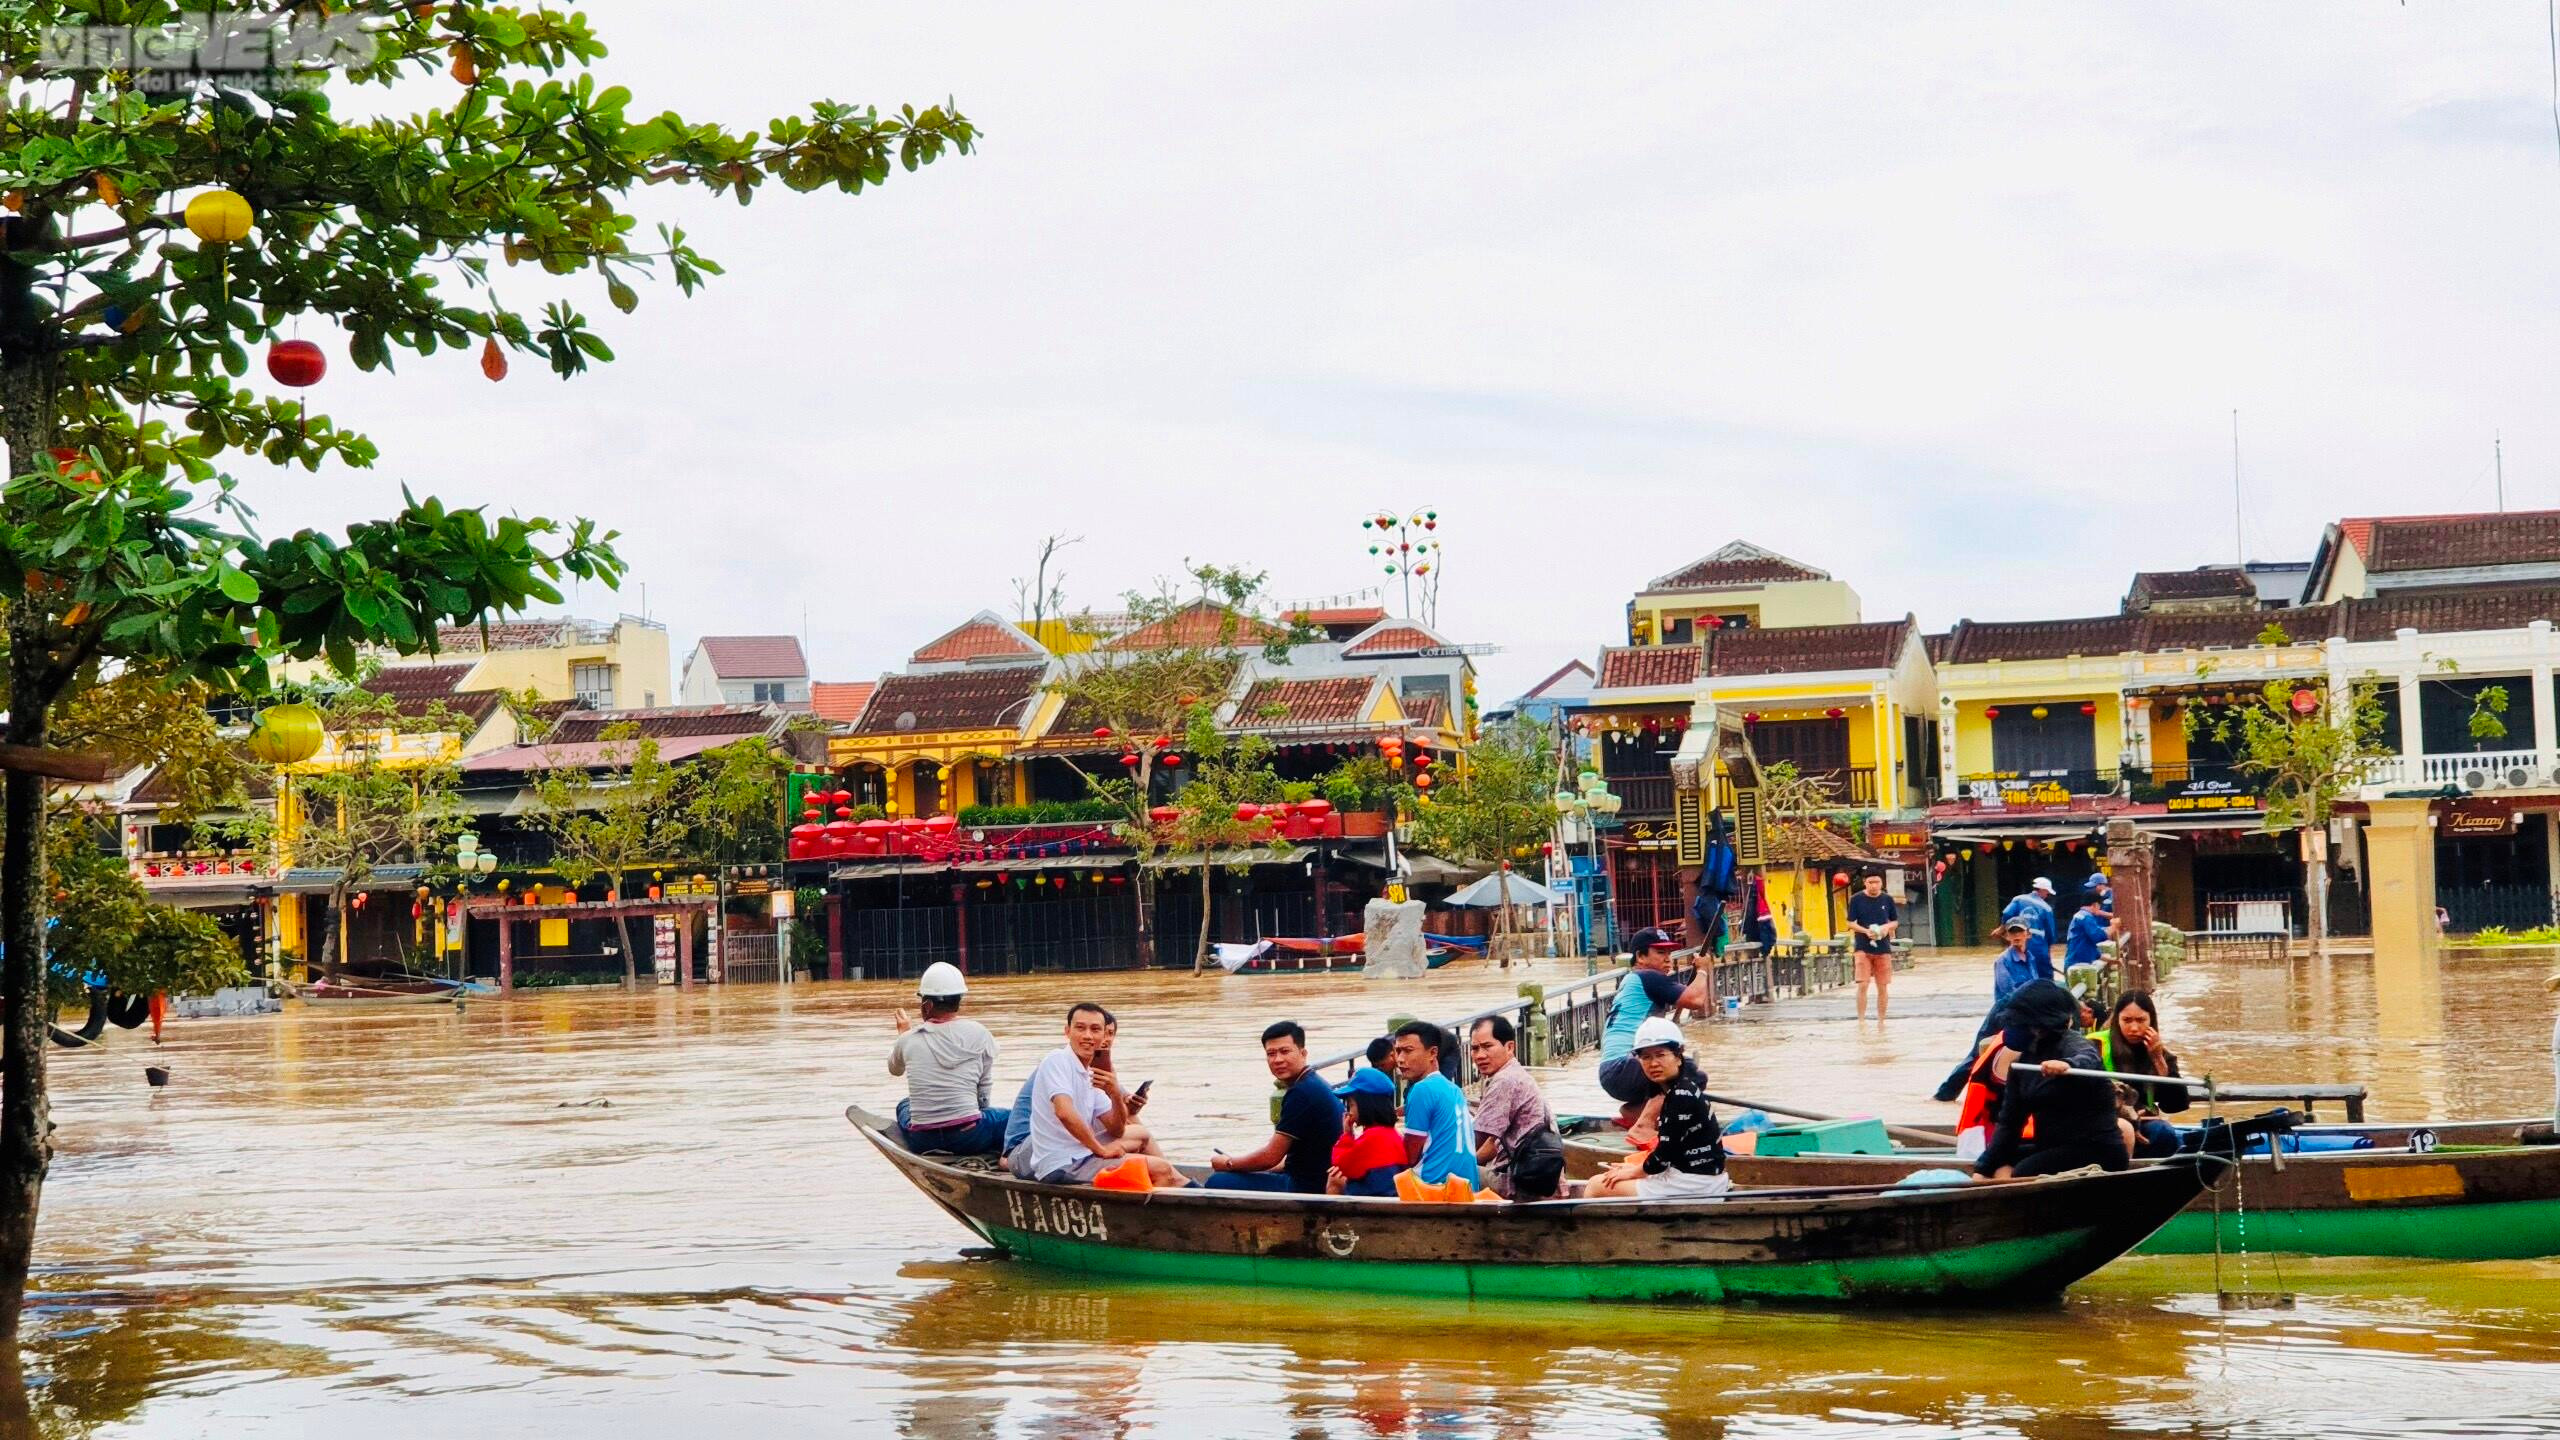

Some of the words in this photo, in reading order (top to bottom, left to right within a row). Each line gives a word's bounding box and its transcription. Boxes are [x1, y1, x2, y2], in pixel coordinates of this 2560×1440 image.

[1970, 781, 1998, 799] SPA
[2448, 812, 2506, 831] Kimmy
[1884, 833, 1911, 846] ATM
